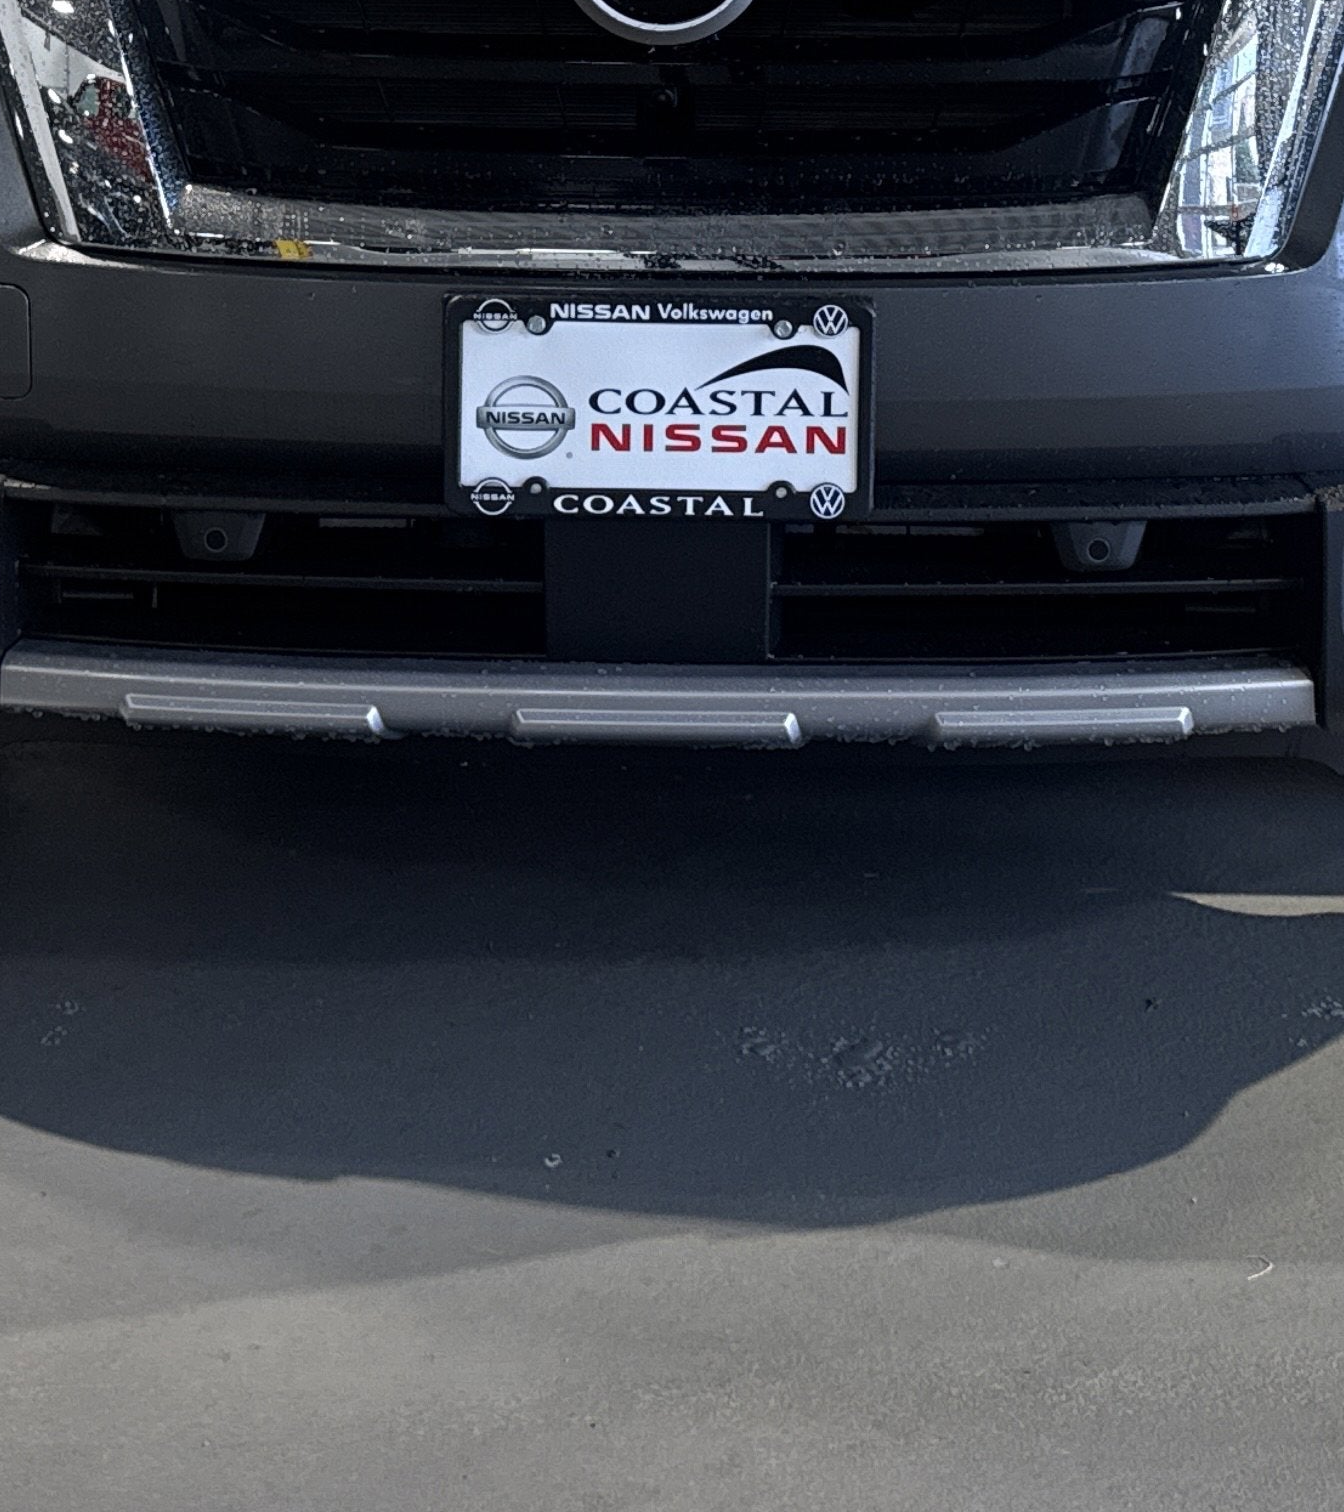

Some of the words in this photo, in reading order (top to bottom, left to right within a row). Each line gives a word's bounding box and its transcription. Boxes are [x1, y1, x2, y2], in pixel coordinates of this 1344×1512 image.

[473, 311, 518, 321] NISSAN
[549, 302, 651, 321] NISSAN
[657, 302, 774, 324] Volkswagen
[588, 387, 849, 418] COASTAL
[485, 410, 567, 426] NISSAN
[590, 423, 847, 455] NISSAN
[470, 491, 516, 503] NISSAN
[552, 494, 764, 518] COASTAL
